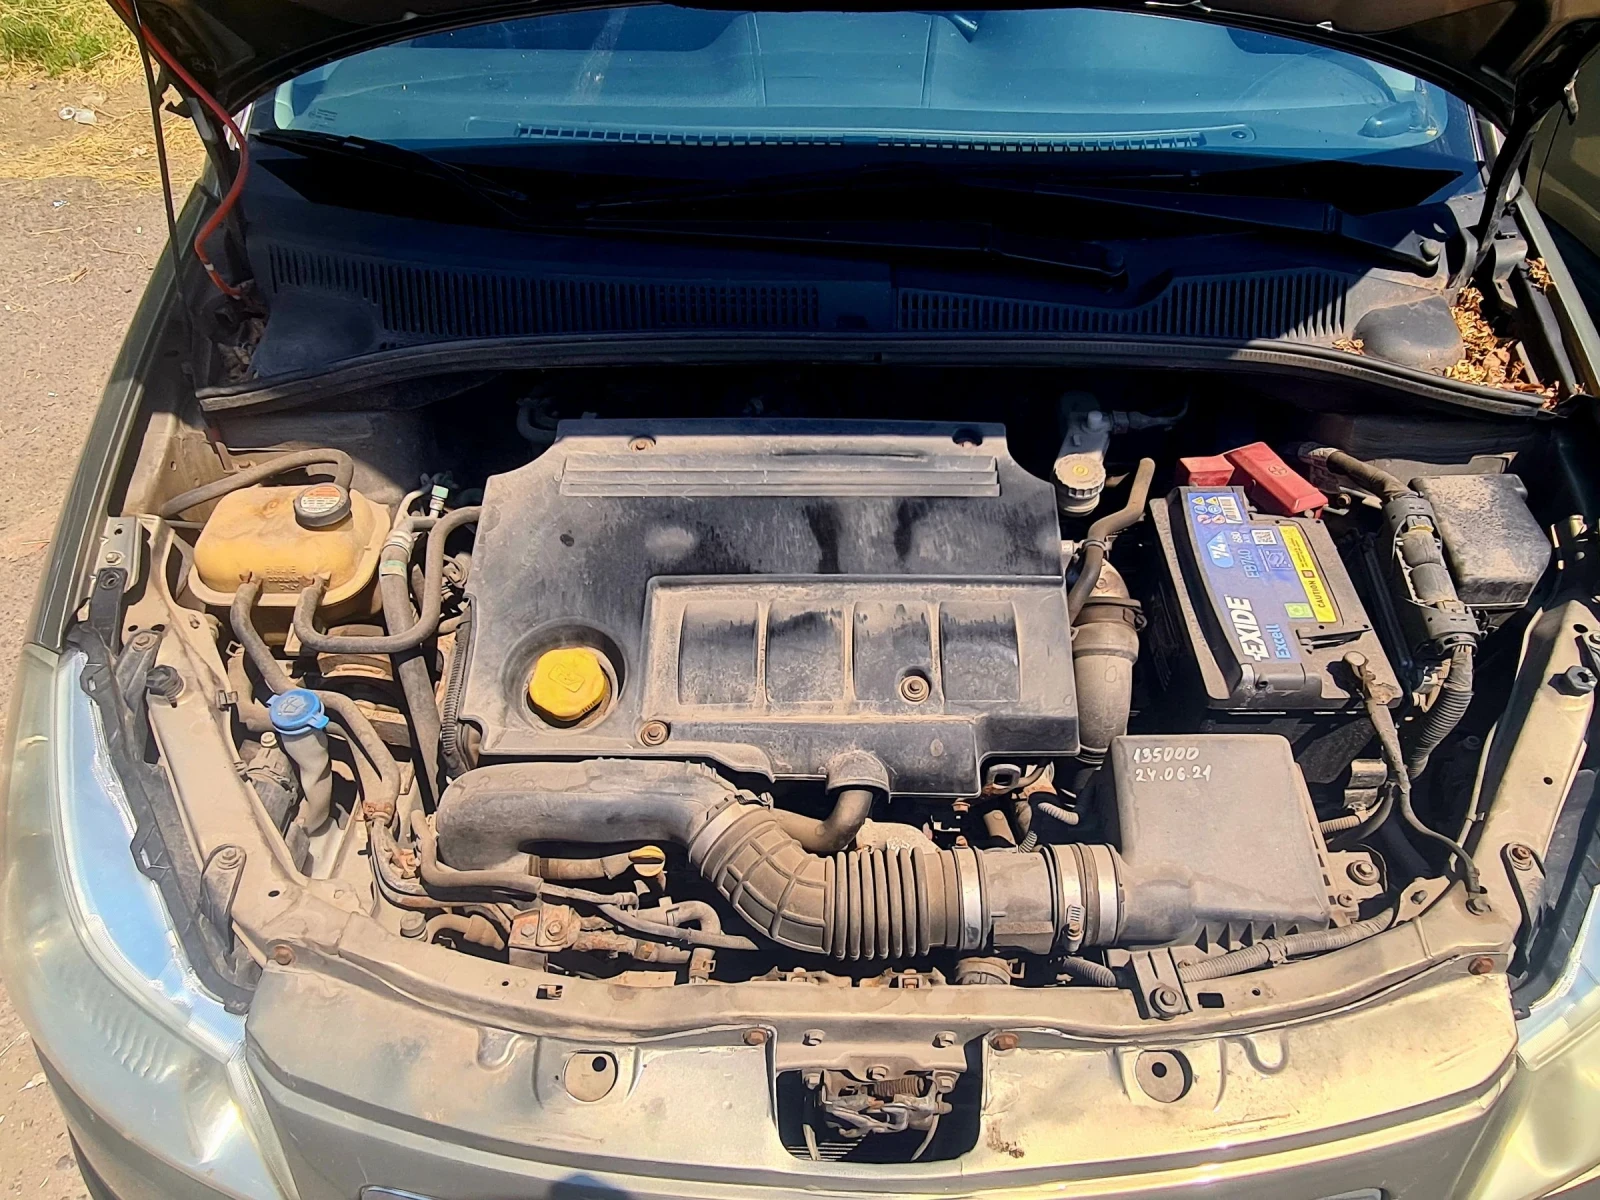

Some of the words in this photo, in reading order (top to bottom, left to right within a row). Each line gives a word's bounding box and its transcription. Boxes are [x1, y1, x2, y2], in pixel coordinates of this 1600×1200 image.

[1210, 544, 1230, 559] 74
[1237, 548, 1260, 578] EB740
[1308, 580, 1326, 608] CAUTION
[1224, 596, 1270, 662] EXIDE
[1265, 623, 1291, 659] Excell
[1133, 746, 1200, 764] 135000
[1135, 764, 1212, 782] 24.06.21
